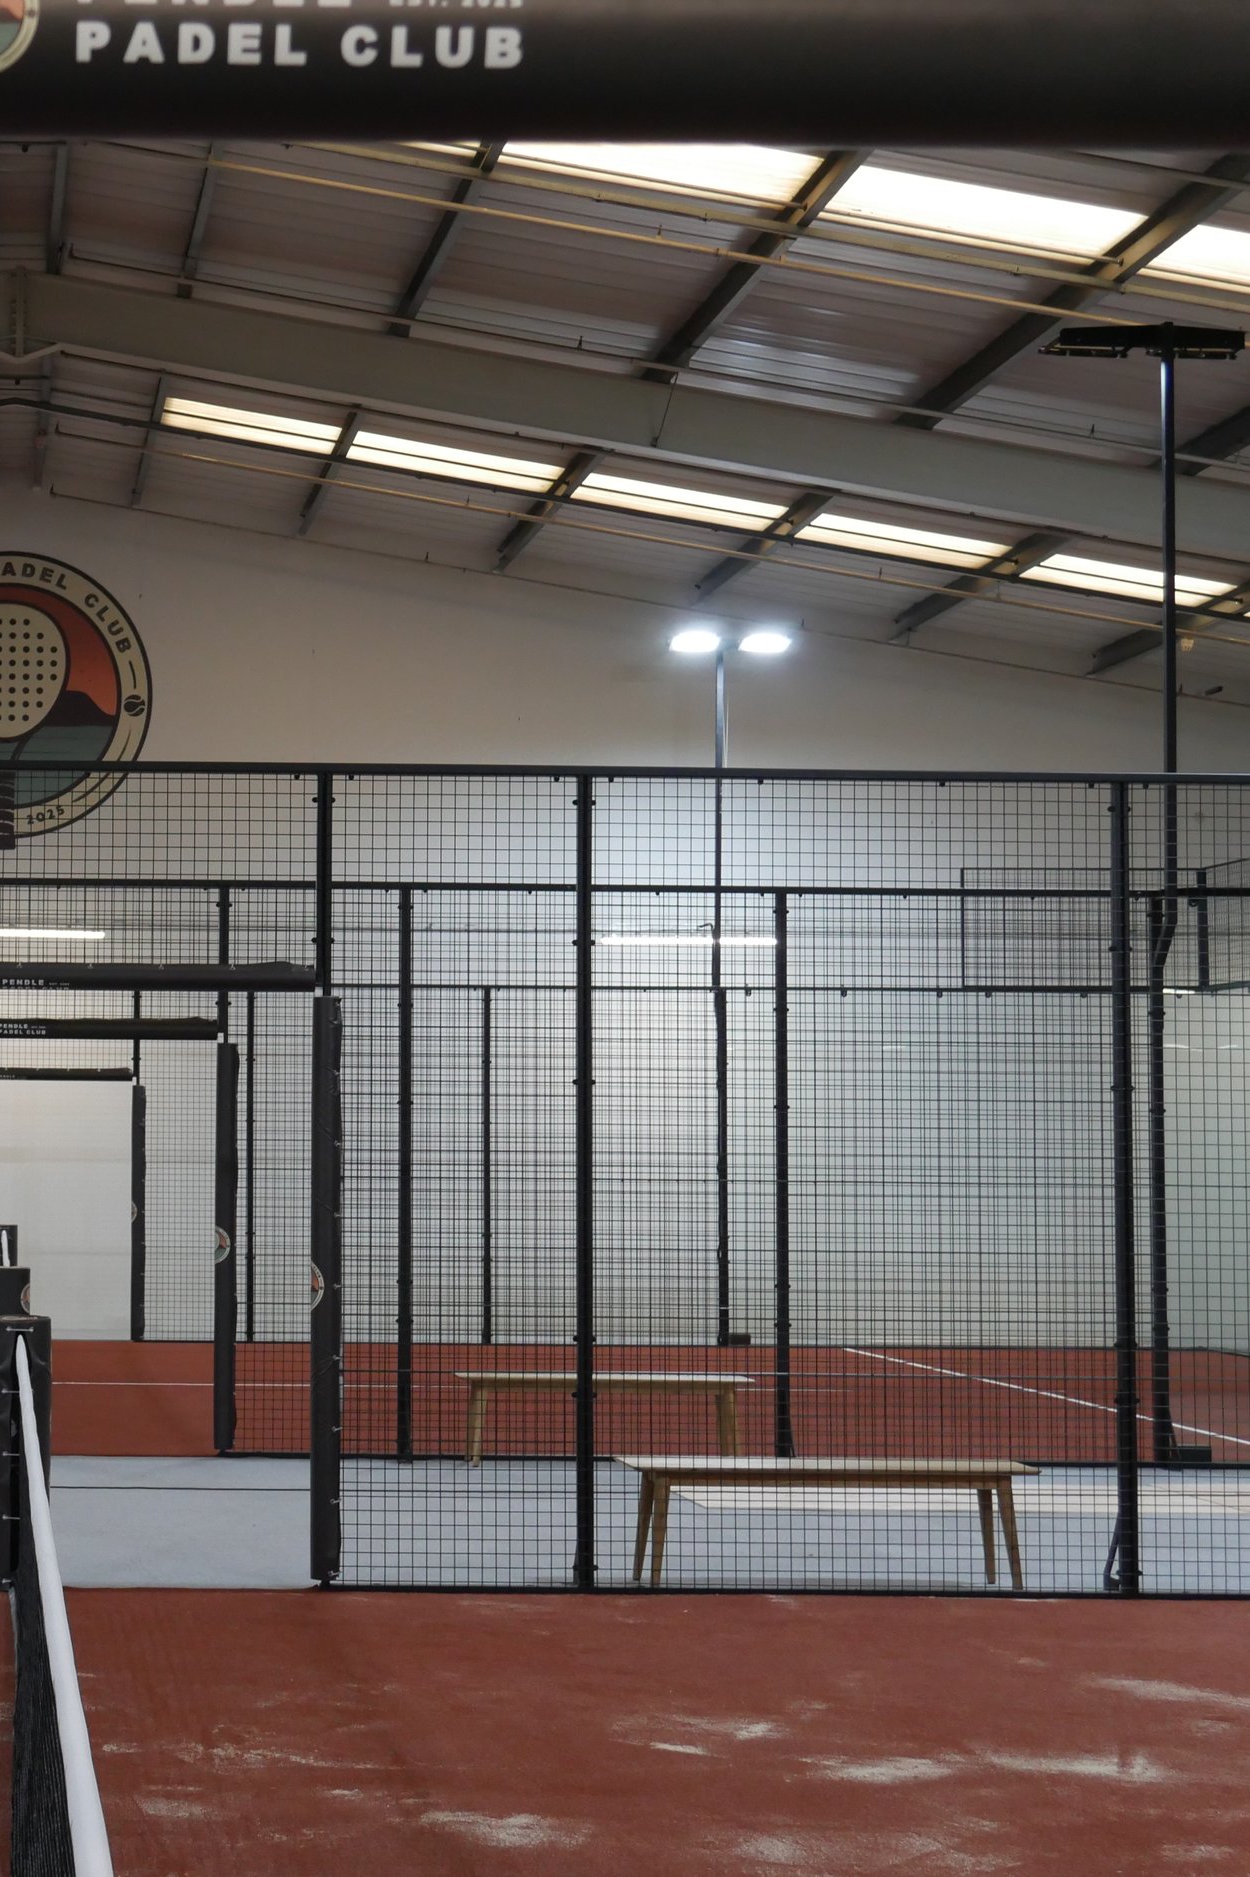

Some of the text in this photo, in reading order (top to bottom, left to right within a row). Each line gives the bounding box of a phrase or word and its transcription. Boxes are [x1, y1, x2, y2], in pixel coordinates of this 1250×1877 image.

[76, 21, 524, 69] PADEL CLUB
[83, 592, 133, 654] CLUB
[26, 804, 66, 825] 2025
